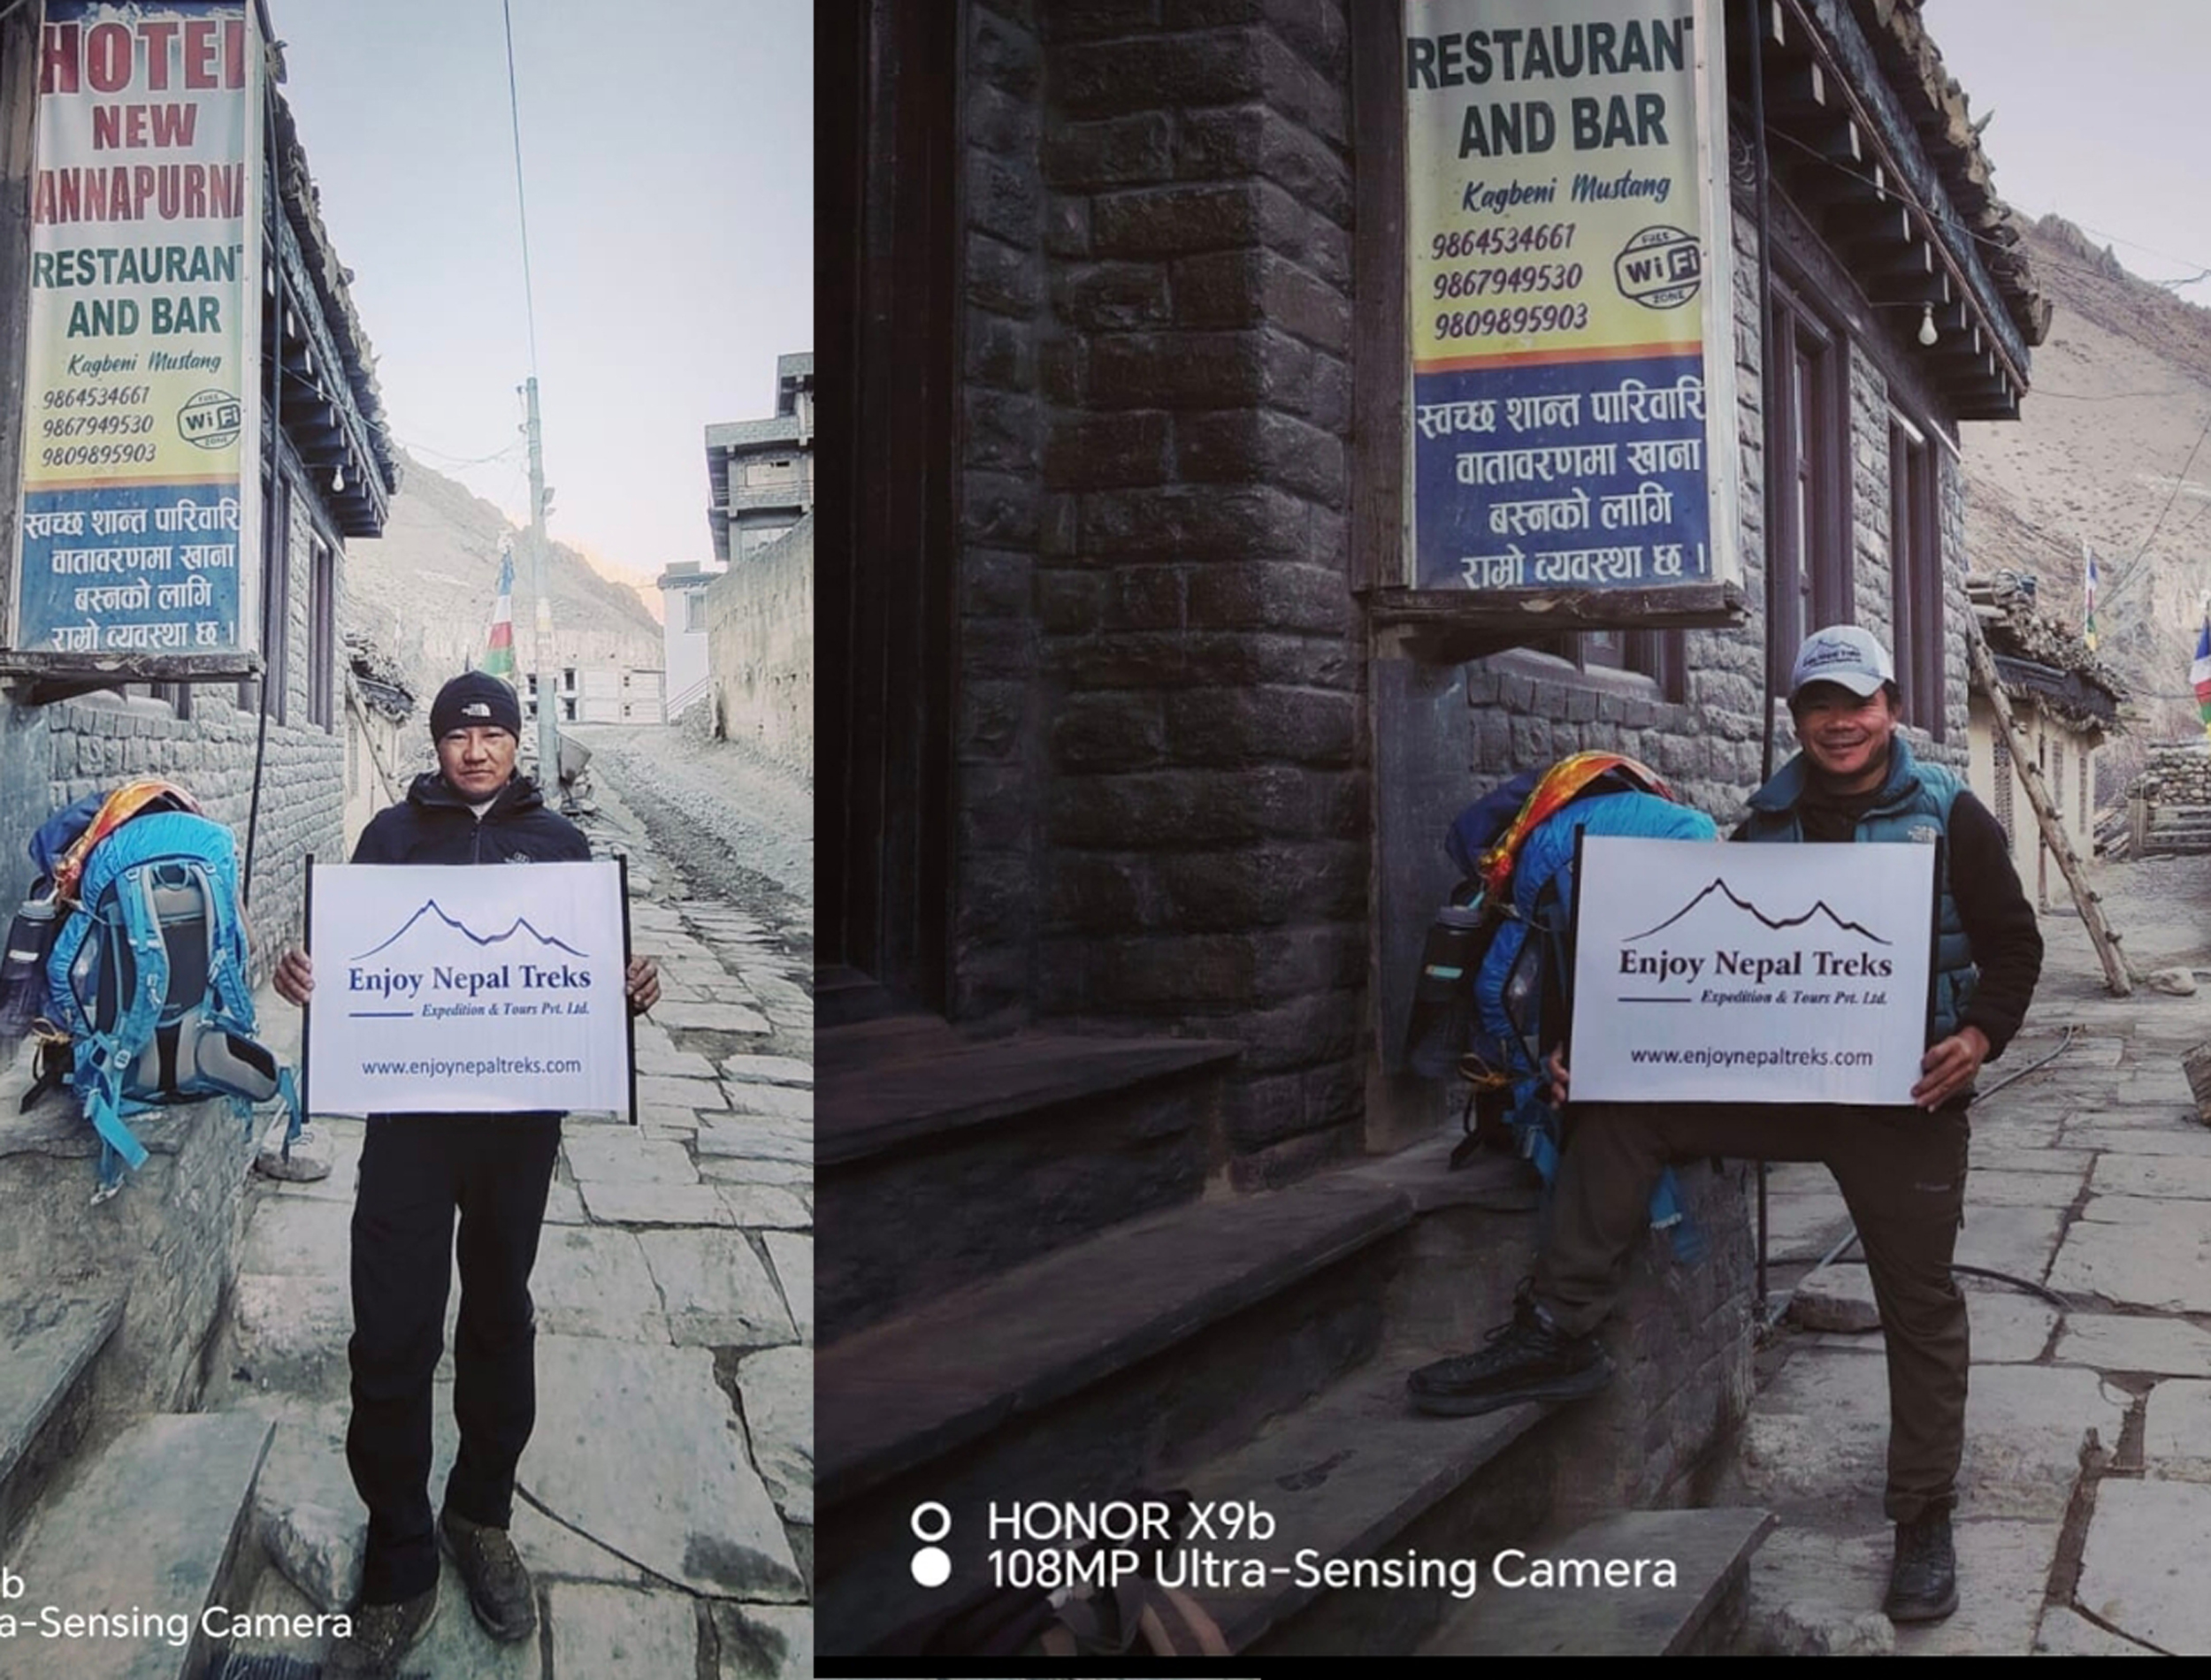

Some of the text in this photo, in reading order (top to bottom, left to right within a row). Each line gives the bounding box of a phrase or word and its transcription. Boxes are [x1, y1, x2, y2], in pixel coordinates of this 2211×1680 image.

[1407, 17, 1694, 90] RESTAURAN
[93, 103, 198, 149] NEW
[1458, 94, 1669, 159] AND BAR
[1463, 171, 1671, 213] Kagbeni Mustang
[1432, 223, 1575, 260] 9864534661
[33, 244, 242, 288] RESTAURAN
[1434, 263, 1583, 300] 9867949530
[67, 296, 221, 338] AND BAR
[1435, 306, 1588, 340] 9809895903
[67, 350, 222, 378] Kagbeni Mustang
[42, 386, 150, 409] 9864534661
[42, 416, 153, 438] 9867949530
[1417, 399, 1497, 439] स्वच्छ
[1506, 393, 1581, 434] शान्त
[42, 444, 157, 467] 9809895903
[1456, 439, 1701, 485] वातावरणमा खाना
[25, 511, 84, 539] स्वच्छ
[91, 508, 146, 536] शान्त
[1488, 483, 1673, 537] बस्नको लागि
[51, 544, 234, 574] वातावरणमा खाना
[1534, 546, 1643, 584] व्यवस्था
[1653, 544, 1682, 577] छ
[74, 576, 211, 613] बस्नको लागि
[107, 622, 189, 649] व्यवस्था
[195, 622, 218, 645] छ
[348, 965, 592, 998] Enjoy Nepal Treks
[1618, 950, 1893, 985] Enjoy Nepal Treks
[422, 1002, 589, 1019] Expedition & Tours Pvt. Ltd.
[1701, 989, 1887, 1005] Expedition & Tours Pvt. Ltd.
[362, 1056, 582, 1078] www.enjoynepaltreks.com
[1631, 1046, 1873, 1068] www.enjoynepaltreks.com
